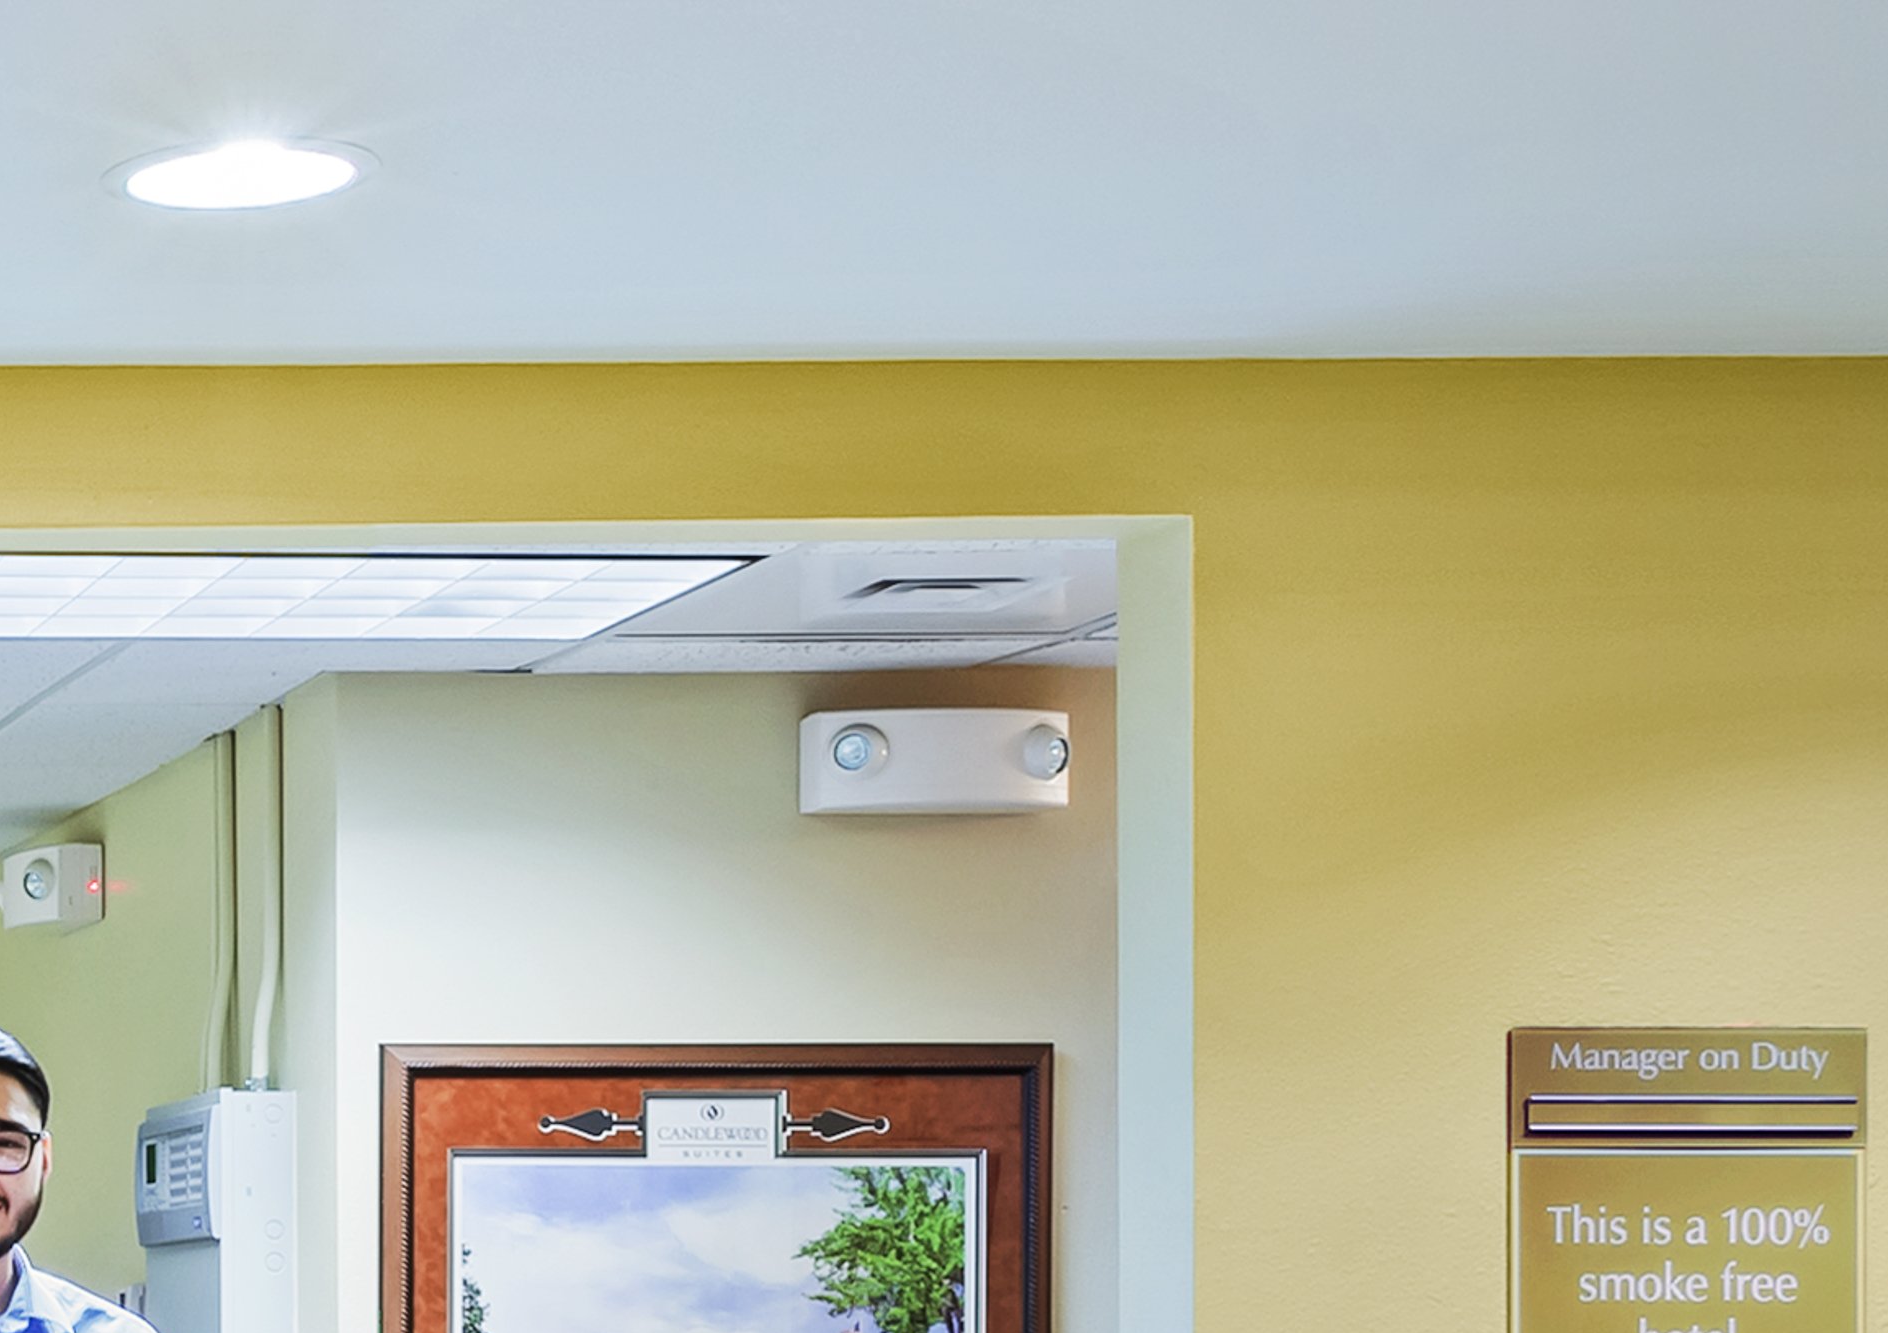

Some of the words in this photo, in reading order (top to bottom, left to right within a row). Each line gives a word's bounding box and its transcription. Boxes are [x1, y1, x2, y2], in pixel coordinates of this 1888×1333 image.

[1550, 1041, 1690, 1081] Manager
[1698, 1048, 1740, 1071] on
[1750, 1042, 1830, 1080] Duty
[657, 1126, 769, 1141] CANDLEWOOD
[1546, 1203, 1628, 1245] This
[1641, 1206, 1672, 1245] is
[1685, 1215, 1708, 1245] a
[1721, 1205, 1830, 1249] 100%
[1578, 1260, 1709, 1303] smoke
[1721, 1260, 1799, 1303] free
